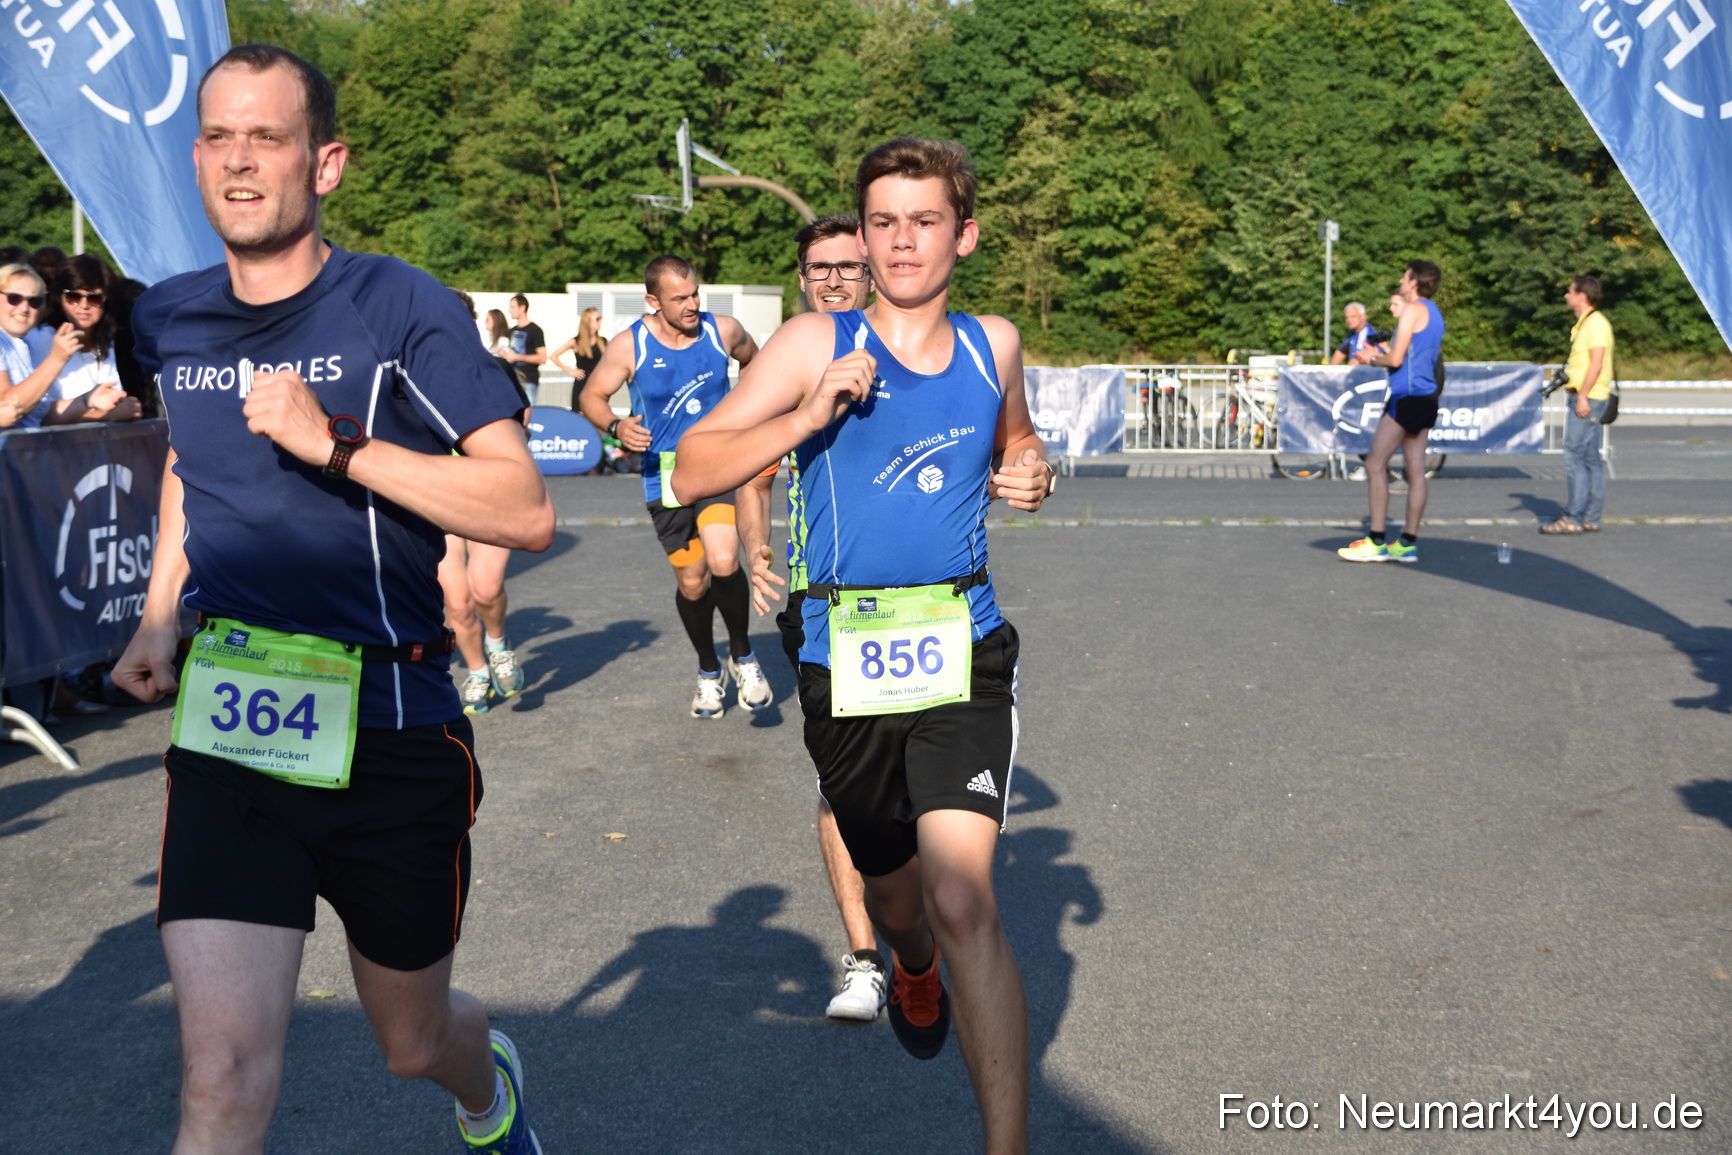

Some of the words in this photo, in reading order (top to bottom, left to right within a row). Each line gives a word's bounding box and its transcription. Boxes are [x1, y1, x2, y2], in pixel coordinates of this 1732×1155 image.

[175, 366, 236, 391] EURO
[869, 389, 891, 399] rima
[662, 397, 677, 415] Team
[528, 435, 589, 453] scher
[872, 456, 903, 485] Team
[903, 433, 946, 457] Schick
[949, 425, 976, 438] Bau
[850, 608, 897, 620] firmenlauf
[212, 640, 270, 661] firmenlauf
[860, 635, 944, 680] 856
[268, 658, 303, 672] 2015
[878, 688, 902, 697] Jonas
[904, 685, 929, 695] Huber
[210, 681, 320, 740] 364
[211, 742, 267, 757] Alexander
[268, 747, 310, 762] Fückert
[251, 759, 269, 768] GmbH
[967, 782, 998, 798] adidas
